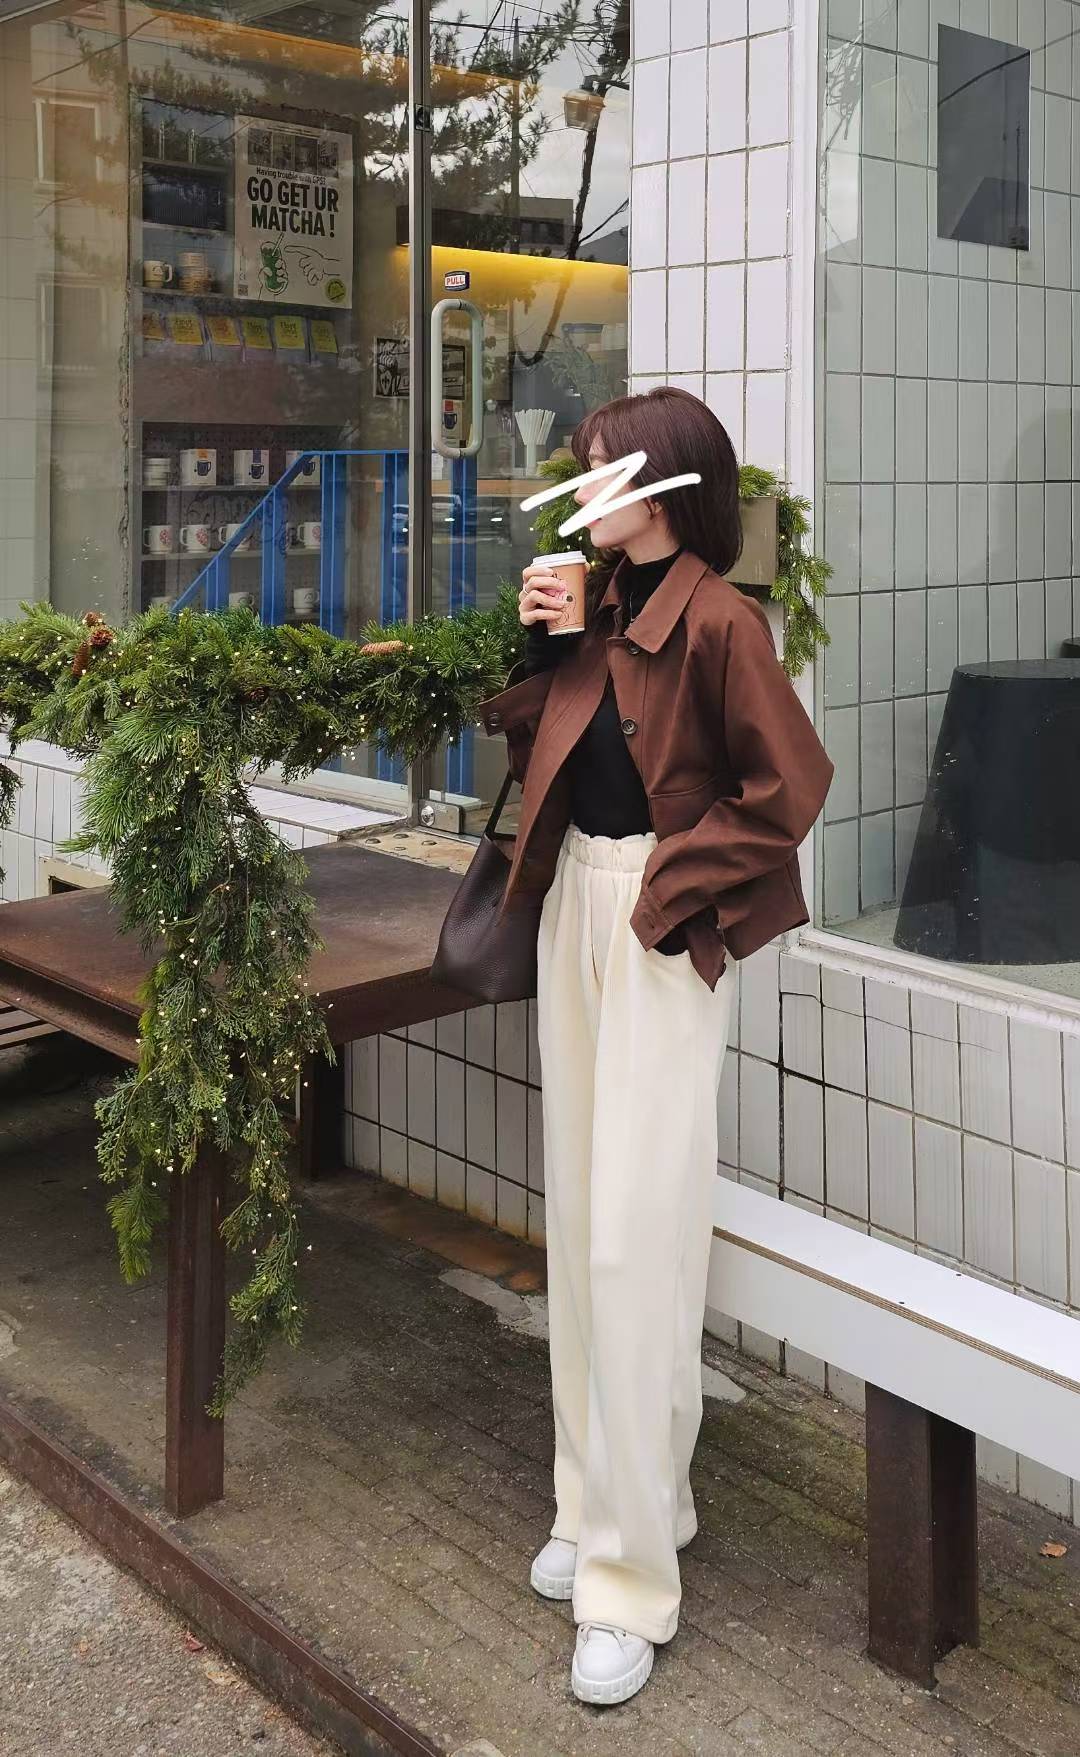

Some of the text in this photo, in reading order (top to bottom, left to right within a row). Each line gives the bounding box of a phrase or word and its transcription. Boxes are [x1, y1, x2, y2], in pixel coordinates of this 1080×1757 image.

[256, 167, 276, 179] Having
[278, 171, 298, 181] trouble
[247, 176, 339, 213] GO GET UR
[446, 276, 464, 285] PULL
